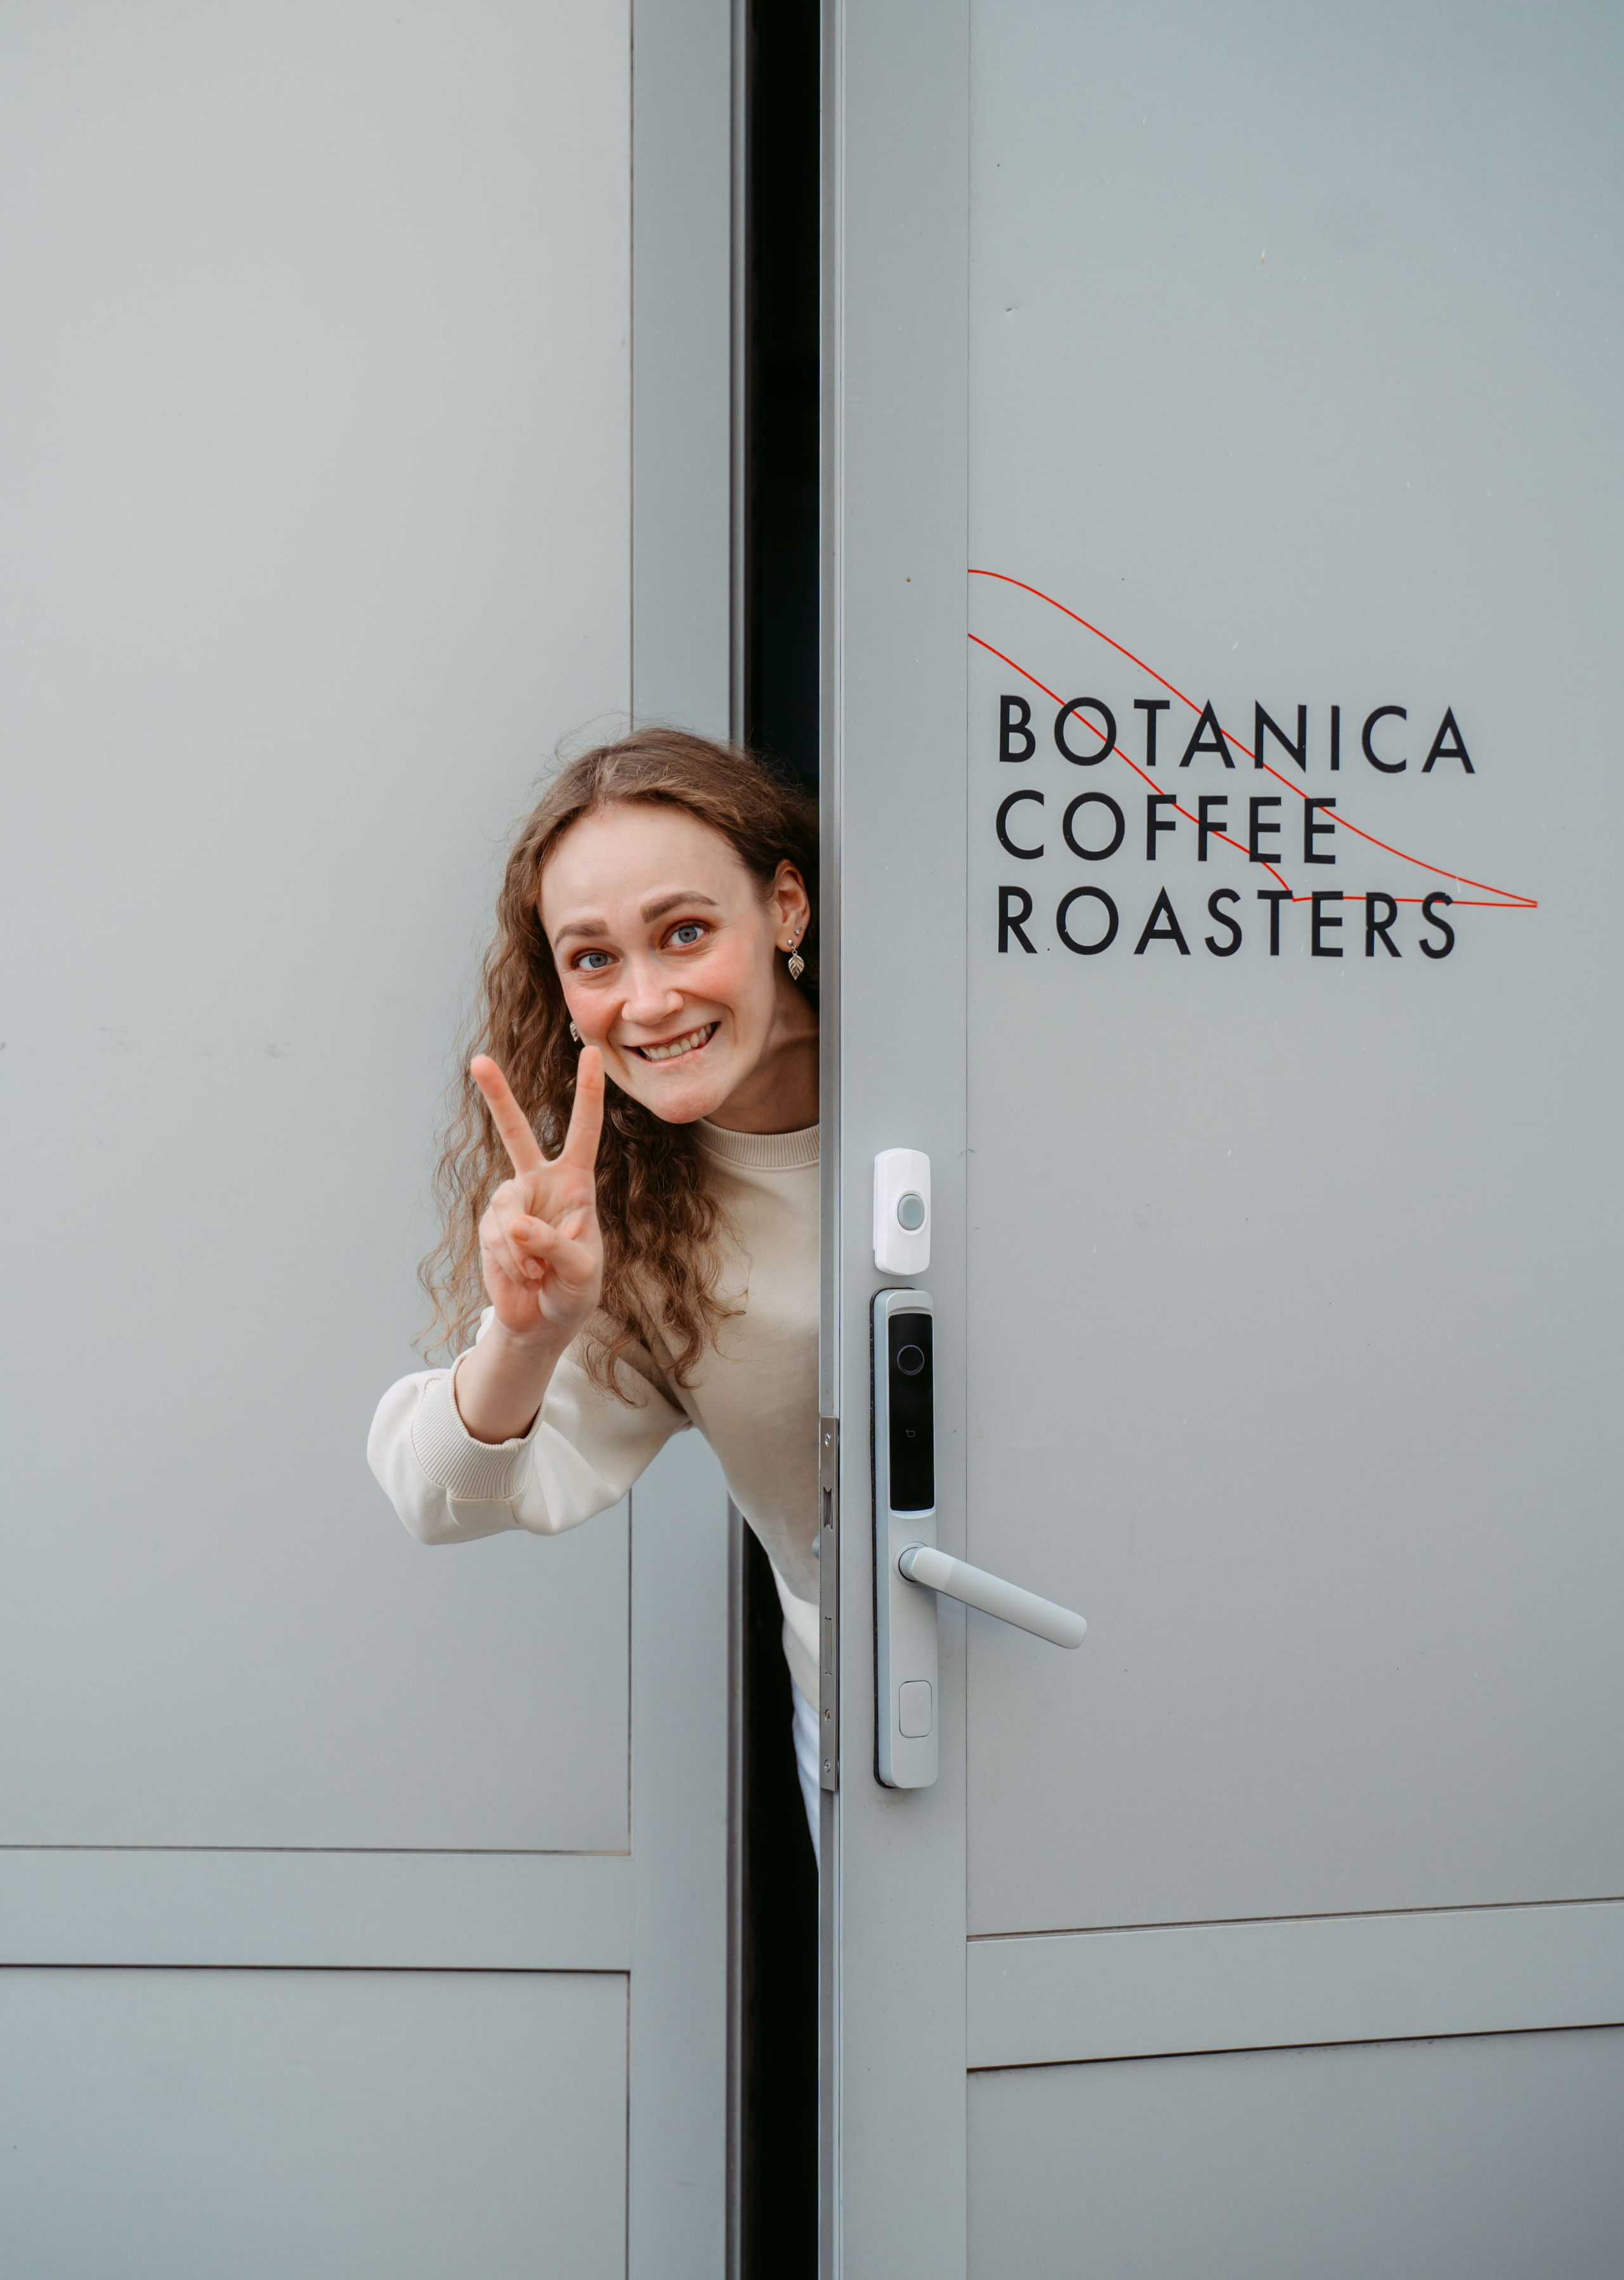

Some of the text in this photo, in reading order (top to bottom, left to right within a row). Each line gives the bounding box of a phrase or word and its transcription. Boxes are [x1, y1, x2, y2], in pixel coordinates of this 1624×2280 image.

[999, 695, 1476, 774] BOTANICA
[995, 789, 1337, 864] COFFEE
[997, 886, 1455, 959] ROASTERS
